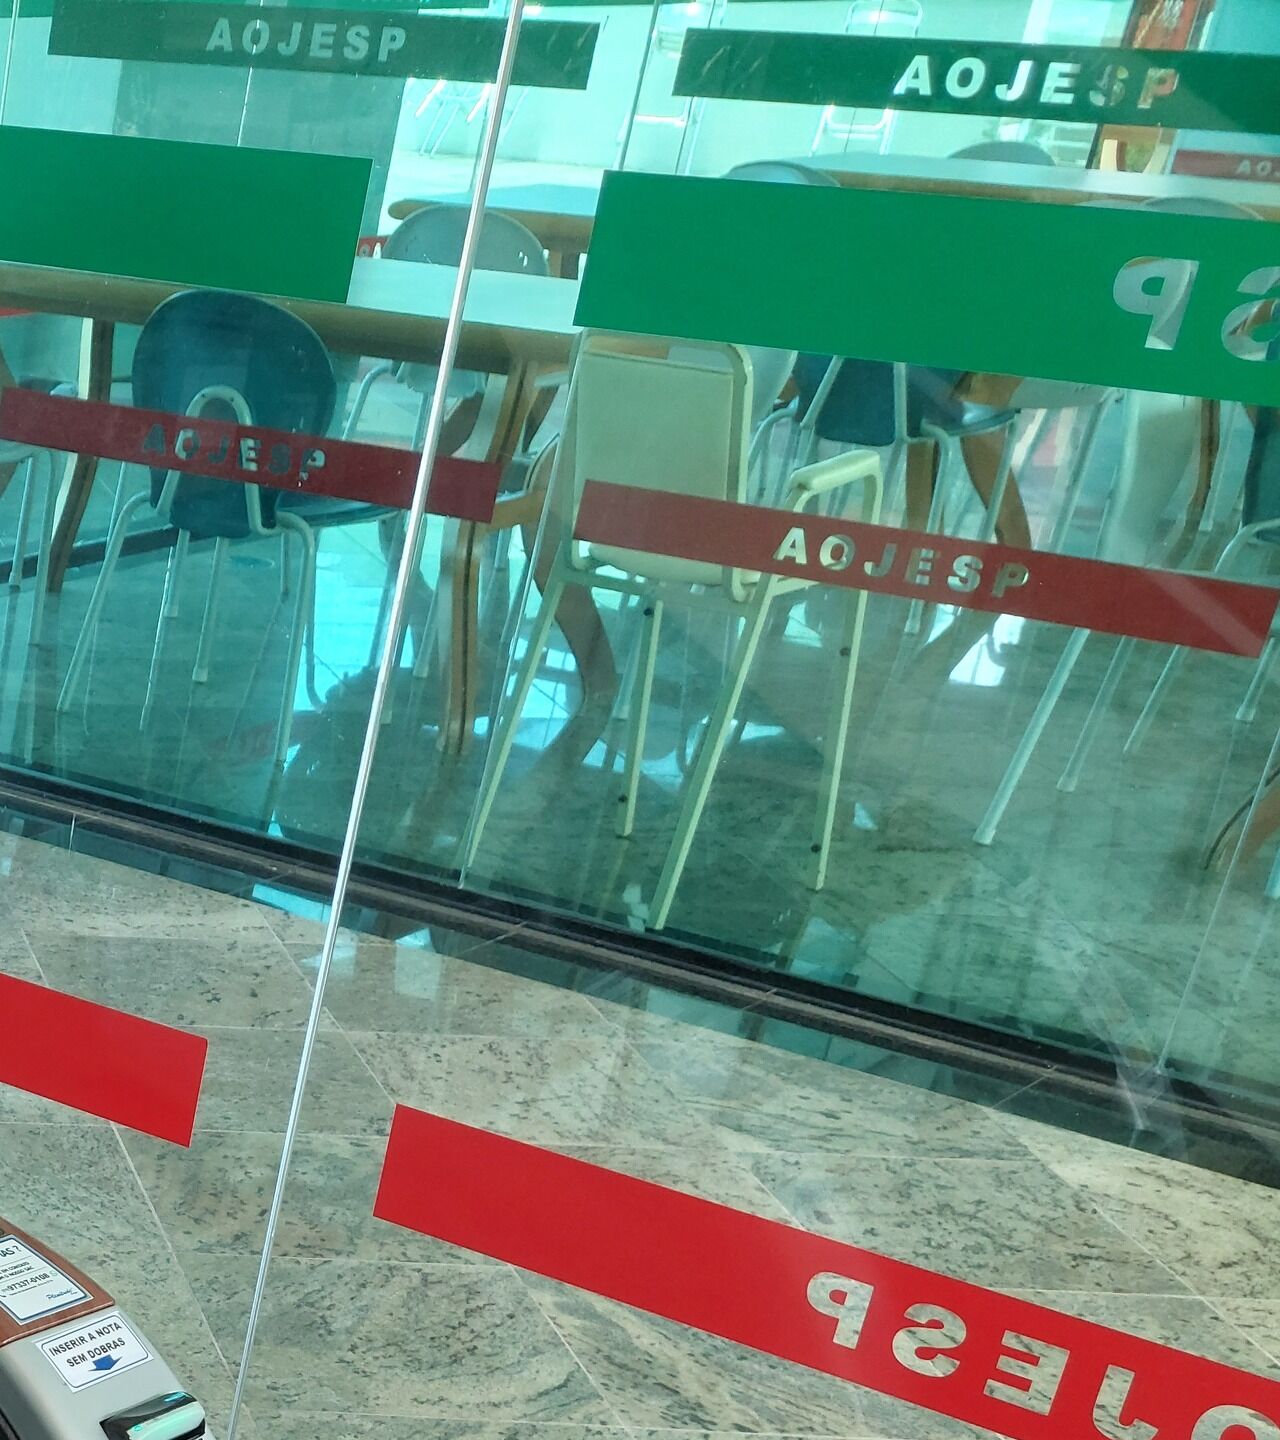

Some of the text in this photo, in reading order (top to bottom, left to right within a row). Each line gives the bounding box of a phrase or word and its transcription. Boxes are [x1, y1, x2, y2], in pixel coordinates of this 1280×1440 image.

[206, 17, 407, 62] AOJESP
[893, 54, 1179, 109] AOJESP
[143, 423, 326, 480] AOJESP
[772, 527, 1029, 598] AOJESP
[48, 1322, 122, 1356] INSERIR A NOTA
[66, 1338, 126, 1367] SEM DOBRAS
